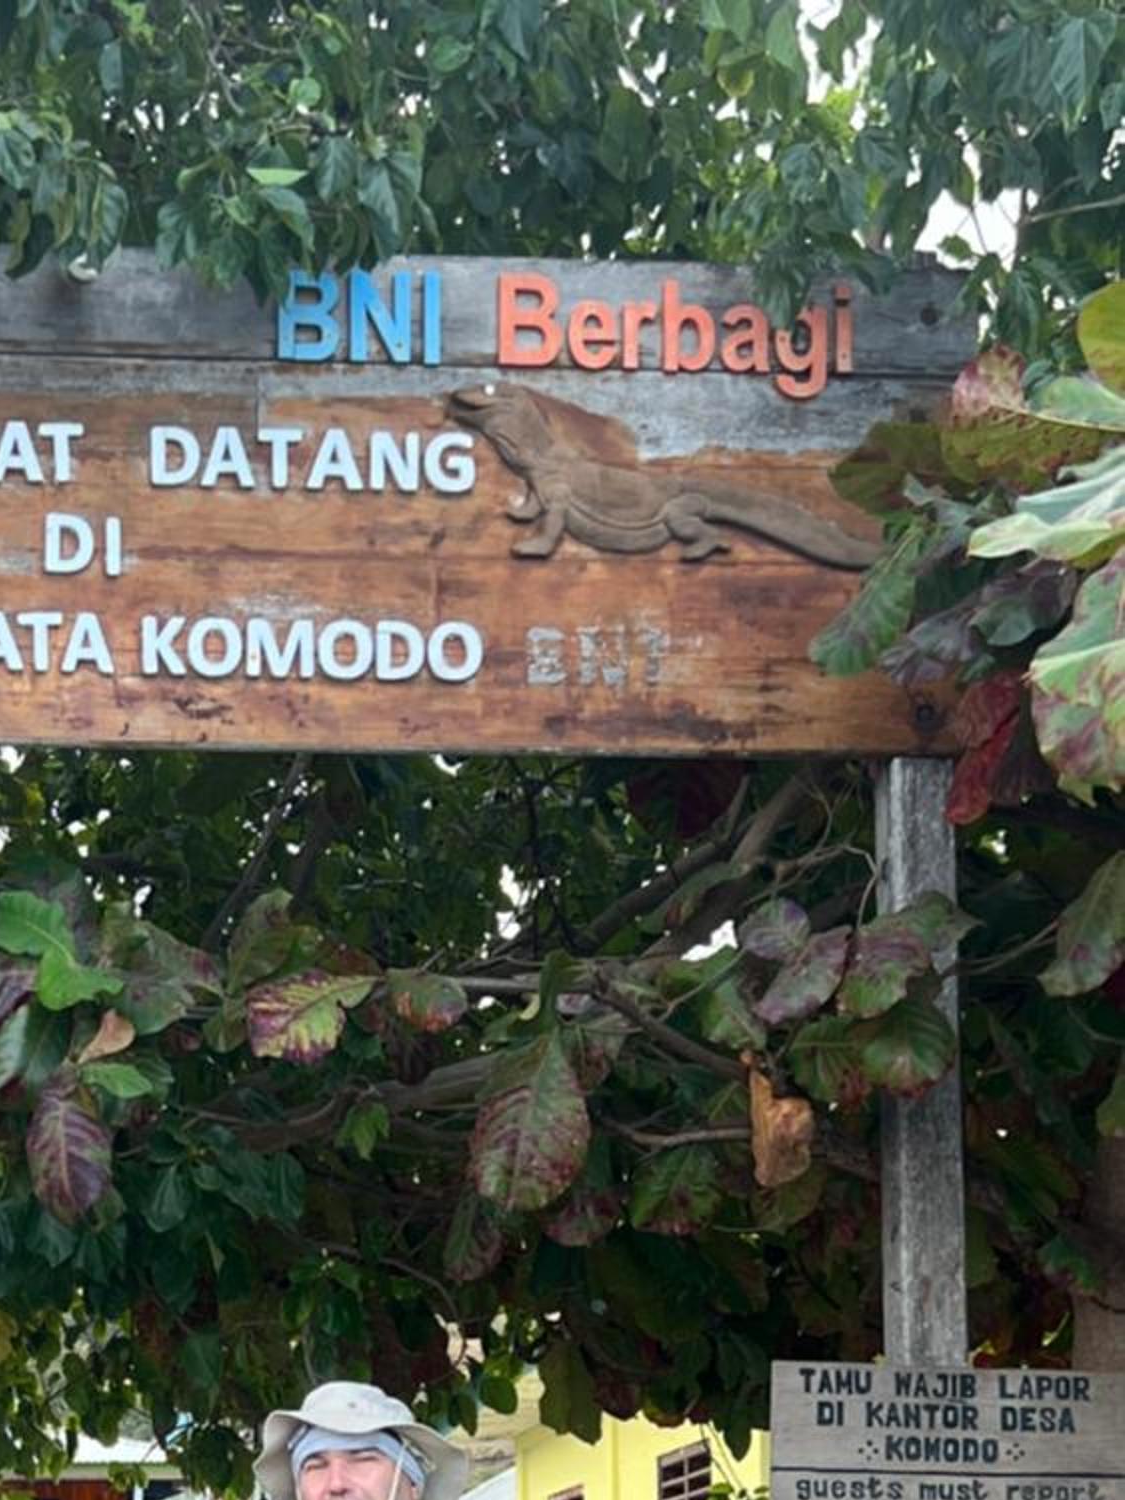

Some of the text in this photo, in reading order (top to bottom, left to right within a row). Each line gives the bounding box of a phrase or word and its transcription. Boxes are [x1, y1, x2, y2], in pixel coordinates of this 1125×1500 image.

[277, 266, 855, 399] BNI Berbagi
[149, 427, 476, 495] DATANG
[44, 512, 123, 577] DI
[141, 614, 485, 685] KOMODO
[799, 1368, 1090, 1401] TAMU WAJIB LAPOR
[817, 1401, 1075, 1433] DI KANTOR DESA
[885, 1436, 999, 1463] KOMODO
[796, 1477, 903, 1500] guests
